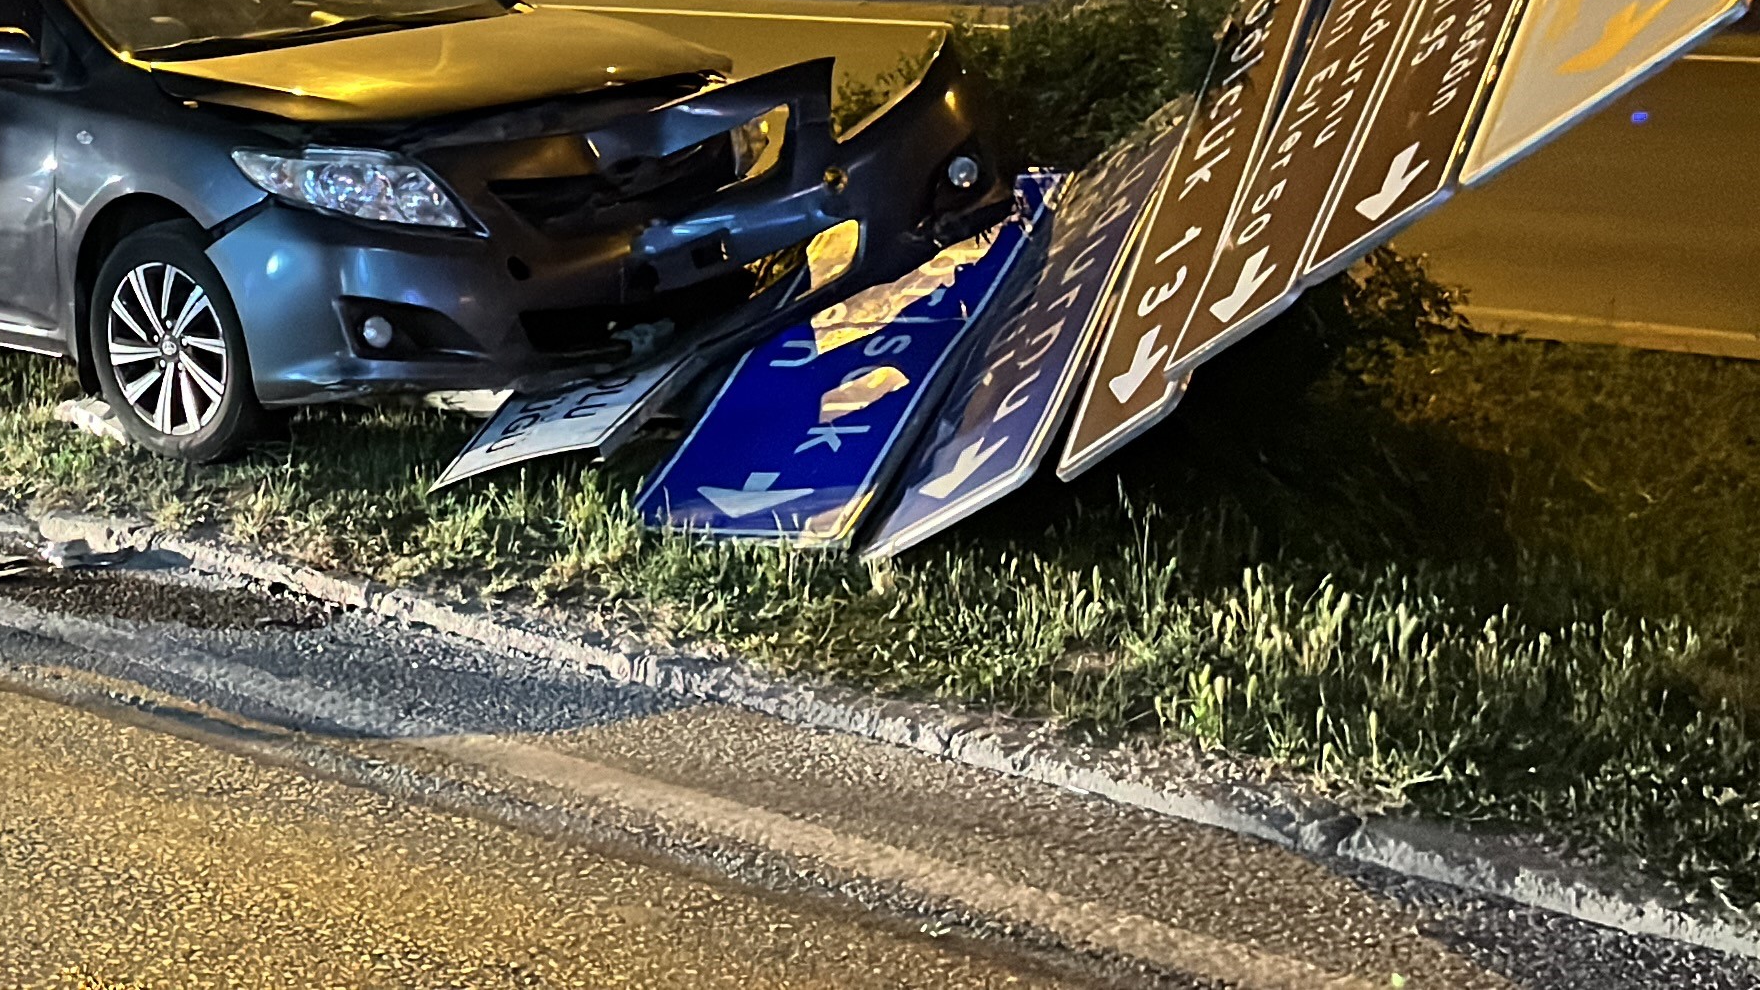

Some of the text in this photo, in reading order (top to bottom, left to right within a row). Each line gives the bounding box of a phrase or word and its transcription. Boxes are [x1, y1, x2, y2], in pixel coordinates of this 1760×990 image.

[1411, 14, 1456, 67] 95
[1271, 60, 1341, 171] Evler
[1237, 179, 1288, 245] 50
[1137, 226, 1202, 317] 13
